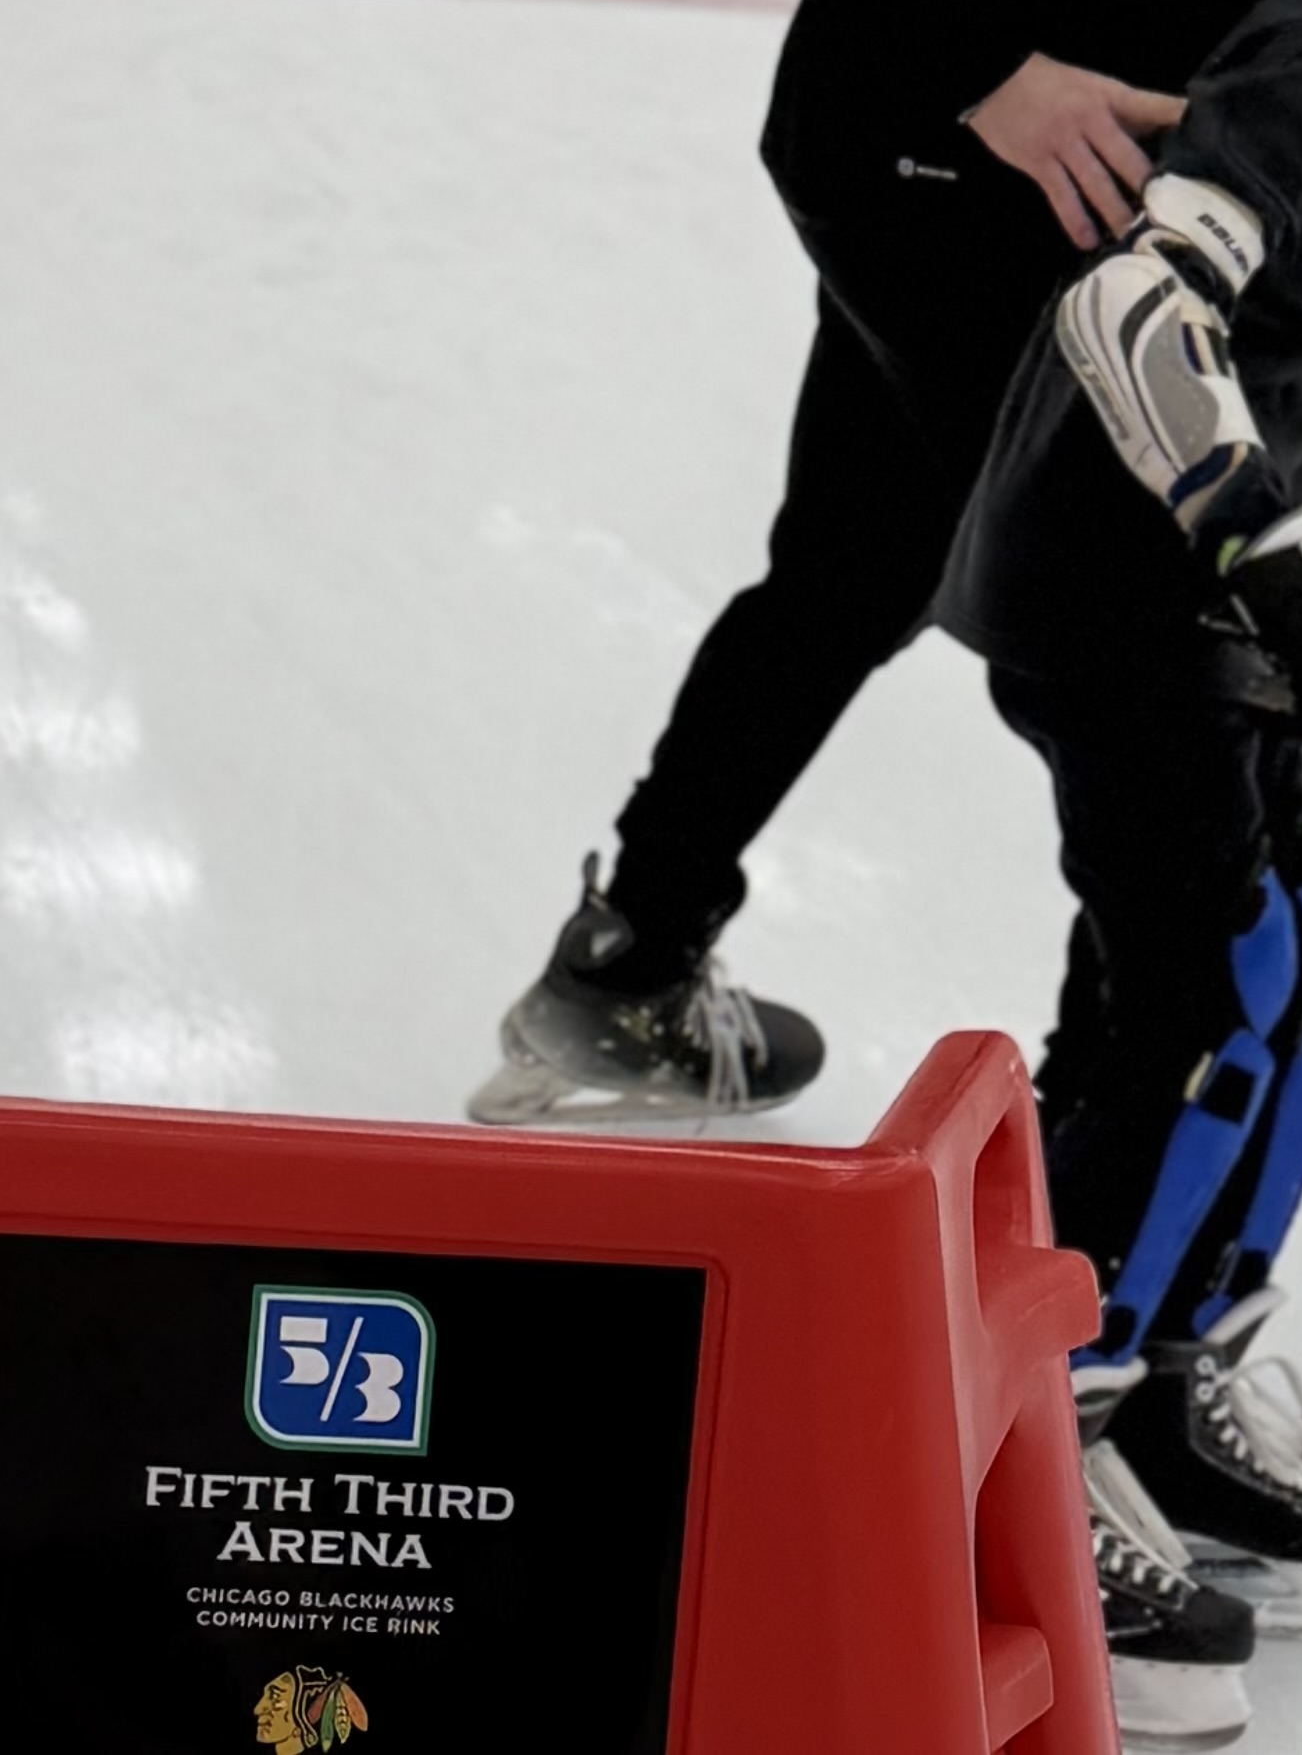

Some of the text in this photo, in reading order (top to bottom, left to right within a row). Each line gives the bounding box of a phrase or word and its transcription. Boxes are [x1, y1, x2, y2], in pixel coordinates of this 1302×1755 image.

[145, 1465, 515, 1522] FIFTH THIRD
[215, 1521, 433, 1569] ARENA
[186, 1586, 455, 1614] CHICAGO BLACKHAWKS
[195, 1610, 441, 1637] COMMUNITY ICE RINK
